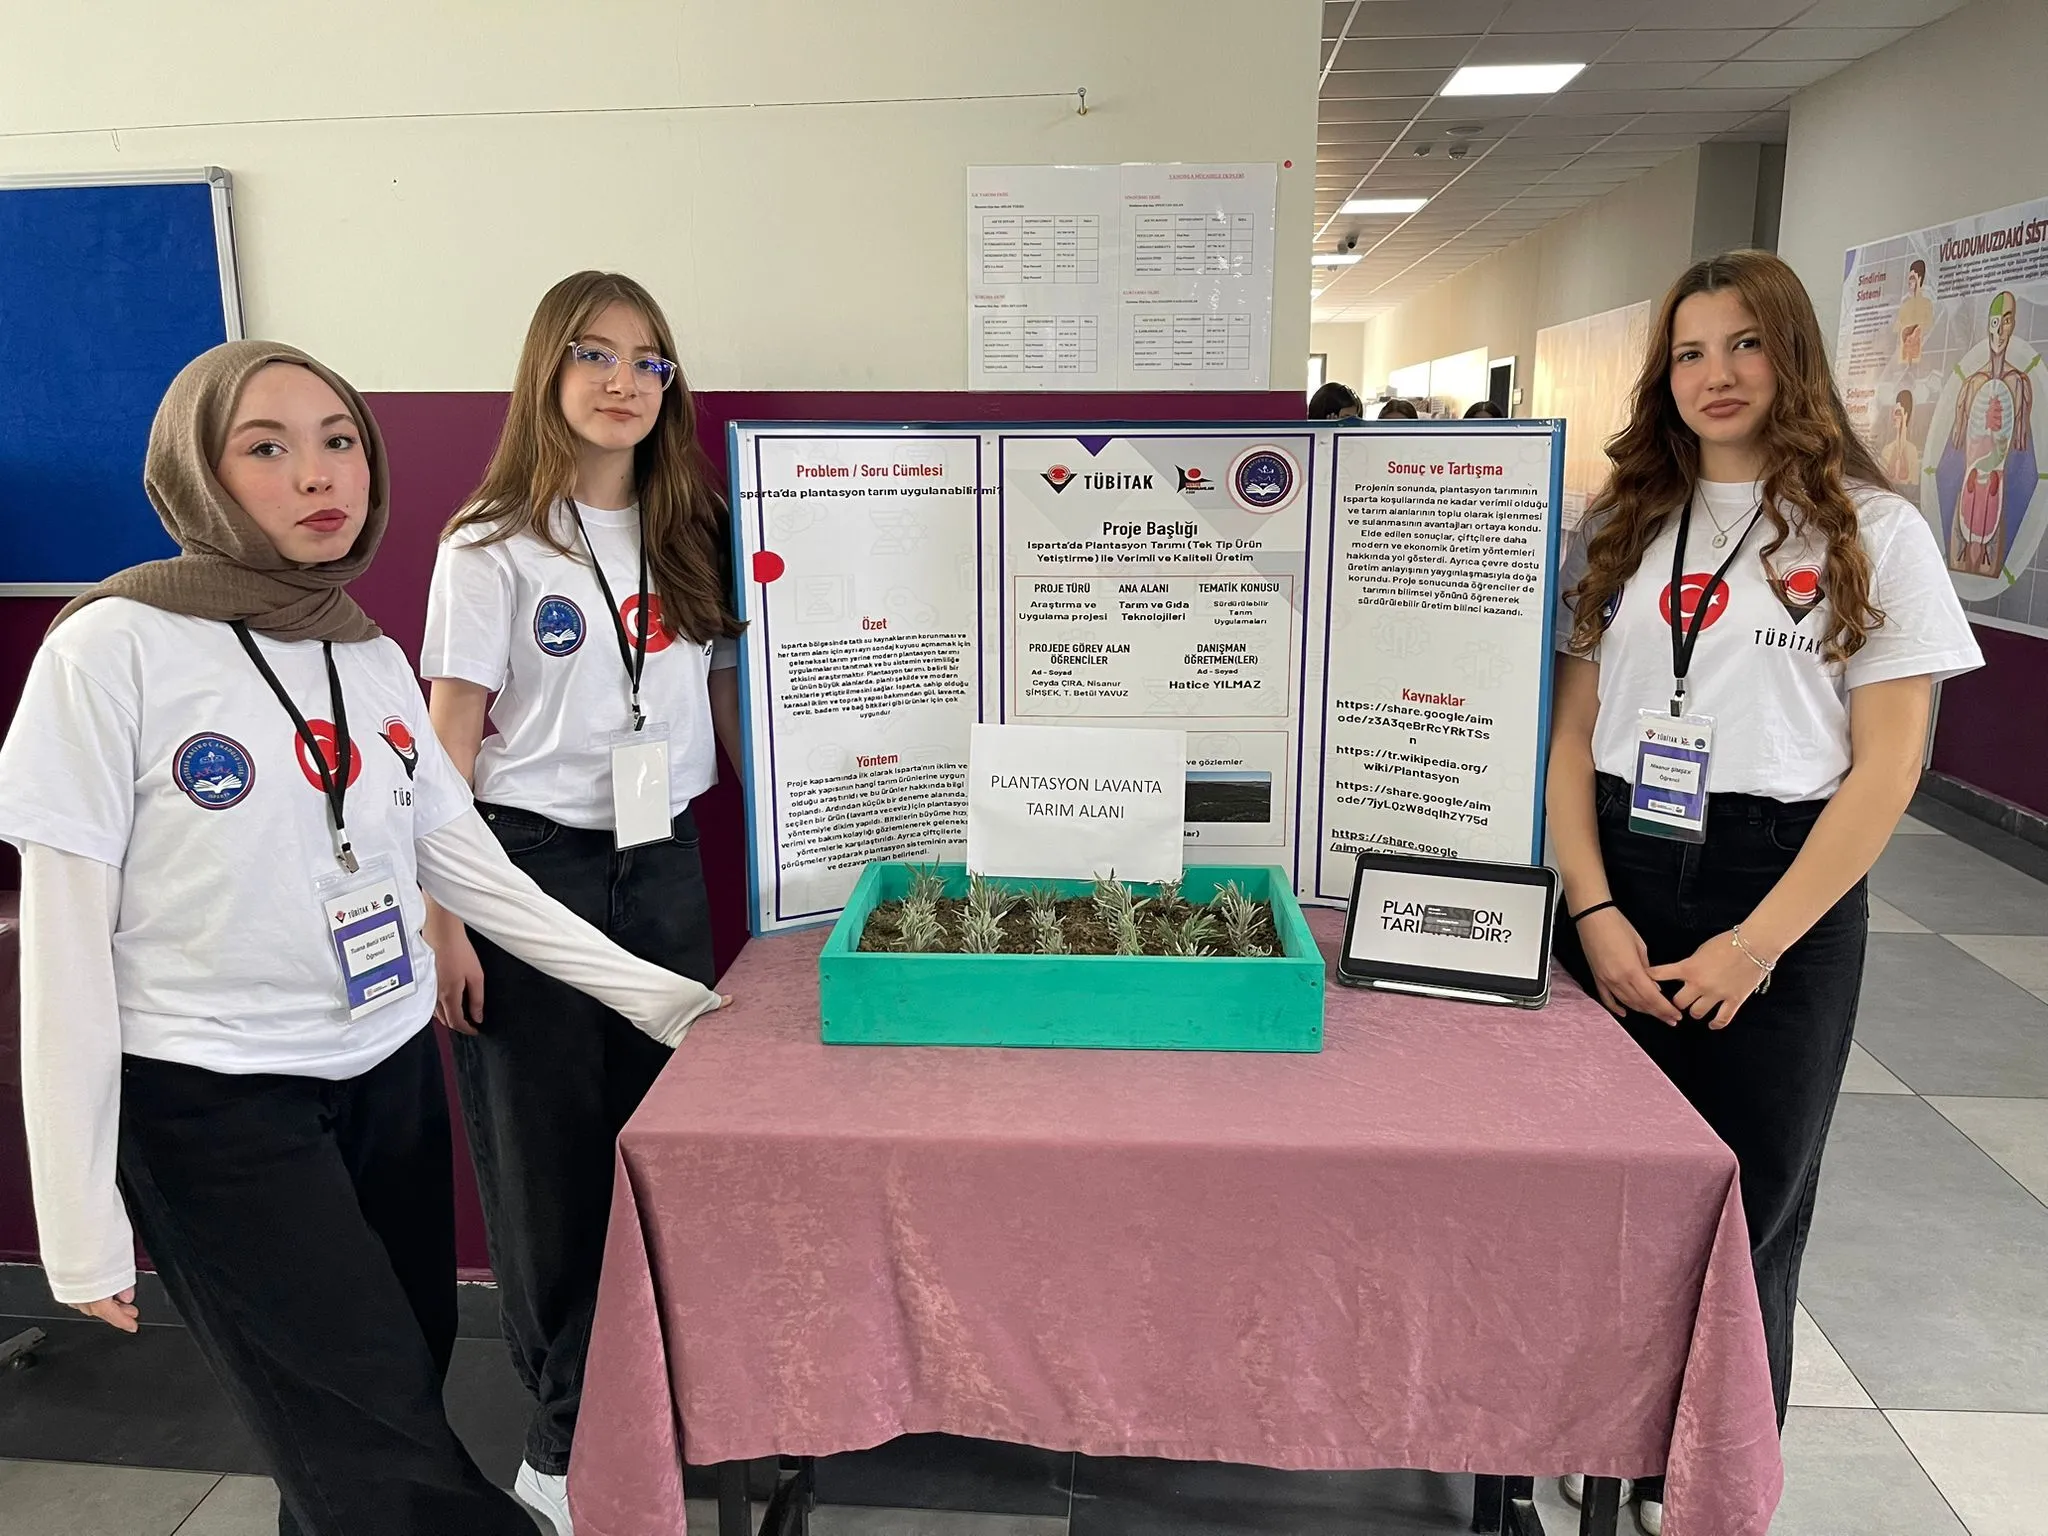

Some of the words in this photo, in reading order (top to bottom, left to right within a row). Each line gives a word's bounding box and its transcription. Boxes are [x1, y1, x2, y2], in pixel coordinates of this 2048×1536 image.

[1939, 221, 2024, 263] VÜCUDUMUZDAKİ
[2025, 218, 2048, 245] SİST
[1858, 271, 1886, 286] Sindirim
[1857, 287, 1881, 301] Sistemi
[796, 464, 849, 477] Problem
[852, 464, 857, 477] /
[861, 464, 888, 477] Soru
[892, 463, 942, 476] Cümlesi
[1387, 460, 1425, 475] Sonuç
[1429, 464, 1444, 474] ve
[1447, 461, 1502, 478] Tartışma
[1084, 471, 1153, 489] TÜBİTAK
[739, 487, 797, 500] sparta'da
[800, 488, 865, 499] plantasyon
[867, 488, 897, 496] tarım
[1354, 483, 1394, 493] Projenin
[1396, 485, 1437, 493] sonunda,
[1439, 485, 1491, 495] plantasyon
[1494, 487, 1537, 495] tarımının
[1343, 495, 1378, 504] Isparta
[1380, 495, 1435, 505] koşullarında
[1479, 498, 1512, 506] verimli
[1514, 500, 1548, 510] olduğu
[1388, 508, 1435, 516] alanlarının
[1437, 509, 1461, 519] toplu
[1463, 510, 1494, 518] olarak
[1495, 511, 1542, 520] işlenmesi
[1103, 521, 1141, 539] Proje
[1146, 520, 1197, 539] Başlığı
[1362, 518, 1422, 527] sulanmasının
[1423, 521, 1472, 530] avantajları
[1474, 522, 1506, 532] ortaya
[1507, 523, 1541, 532] kondu.
[1085, 537, 1147, 550] Plantasyon
[1150, 537, 1185, 549] Tarımı
[1187, 537, 1212, 549] (Tek
[1215, 540, 1232, 550] Tip
[1235, 538, 1262, 548] Ürün
[1360, 529, 1382, 537] Elde
[1384, 530, 1411, 538] edilen
[1413, 532, 1454, 541] sonuçlar,
[1457, 533, 1500, 543] çiftçilere
[1503, 536, 1527, 544] daha
[1351, 541, 1389, 549] modern
[1403, 543, 1447, 552] ekonomik
[1449, 544, 1480, 553] üretim
[1482, 546, 1535, 556] yöntemleri
[1036, 553, 1099, 564] Yetiştirme)
[1116, 554, 1155, 562] Verimli
[1173, 553, 1212, 561] Kaliteli
[1215, 552, 1253, 561] Üretim
[1346, 552, 1390, 560] hakkında
[1391, 554, 1405, 562] yol
[1407, 554, 1447, 563] gösterdi.
[1449, 556, 1480, 566] Ayrıca
[1481, 559, 1508, 567] çevre
[1511, 560, 1539, 569] dostu
[1347, 562, 1379, 571] üretim
[1381, 565, 1429, 575] anlayışının
[1430, 568, 1510, 580] yaygınlaşmasıyla
[1512, 573, 1537, 583] doğa
[1034, 583, 1063, 593] PROJE
[1065, 582, 1090, 593] TÜRÜ
[1118, 583, 1138, 593] ANA
[1140, 583, 1168, 593] ALANI
[1198, 581, 1238, 592] TEMATİK
[1240, 582, 1279, 592] KONUSU
[1348, 574, 1390, 583] korundu.
[1392, 576, 1416, 586] Proje
[1418, 579, 1469, 588] sonucunda
[1470, 580, 1520, 591] öğrenciler
[1522, 585, 1534, 593] de
[1362, 586, 1396, 594] tarımın
[1397, 587, 1432, 597] bilimsel
[1434, 590, 1468, 600] yönünü
[1470, 592, 1519, 604] öğrenerek
[1030, 600, 1082, 609] Araştırma
[1118, 600, 1148, 608] Tarım
[1165, 600, 1189, 608] Gıda
[862, 616, 887, 630] Özet
[1018, 612, 1069, 621] Uygulama
[1071, 612, 1107, 621] projesi
[1121, 612, 1185, 622] Teknolojileri
[1029, 644, 1070, 653] PROJEDE
[1072, 642, 1103, 653] GÖREV
[1105, 644, 1130, 653] ALAN
[1755, 628, 1822, 655] TÜBİTAK
[1196, 643, 1246, 655] DANIŞMAN
[1050, 653, 1108, 664] ÖĞRENCİLER
[1184, 652, 1258, 665] ÖĞRETMEN(LER)
[1061, 679, 1084, 687] ÇIRA,
[1169, 680, 1209, 689] Hatice
[1213, 680, 1261, 688] YILMAZ
[1402, 687, 1465, 706] Kaynaklar
[1336, 699, 1493, 725] https://share.google/aim
[856, 754, 898, 767] Yöntem
[1198, 758, 1243, 767] gözlemler
[1336, 745, 1488, 774] https://tr.wikipedia.org/
[1363, 762, 1459, 783] wiki/Plantasyon
[991, 775, 1088, 791] PLANTASYON
[1094, 778, 1161, 793] LAVANTA
[1335, 780, 1491, 811] https://share.google/aim
[1026, 802, 1073, 816] TARIM
[1078, 804, 1123, 818] ALANI
[1331, 828, 1458, 858] https://share.google
